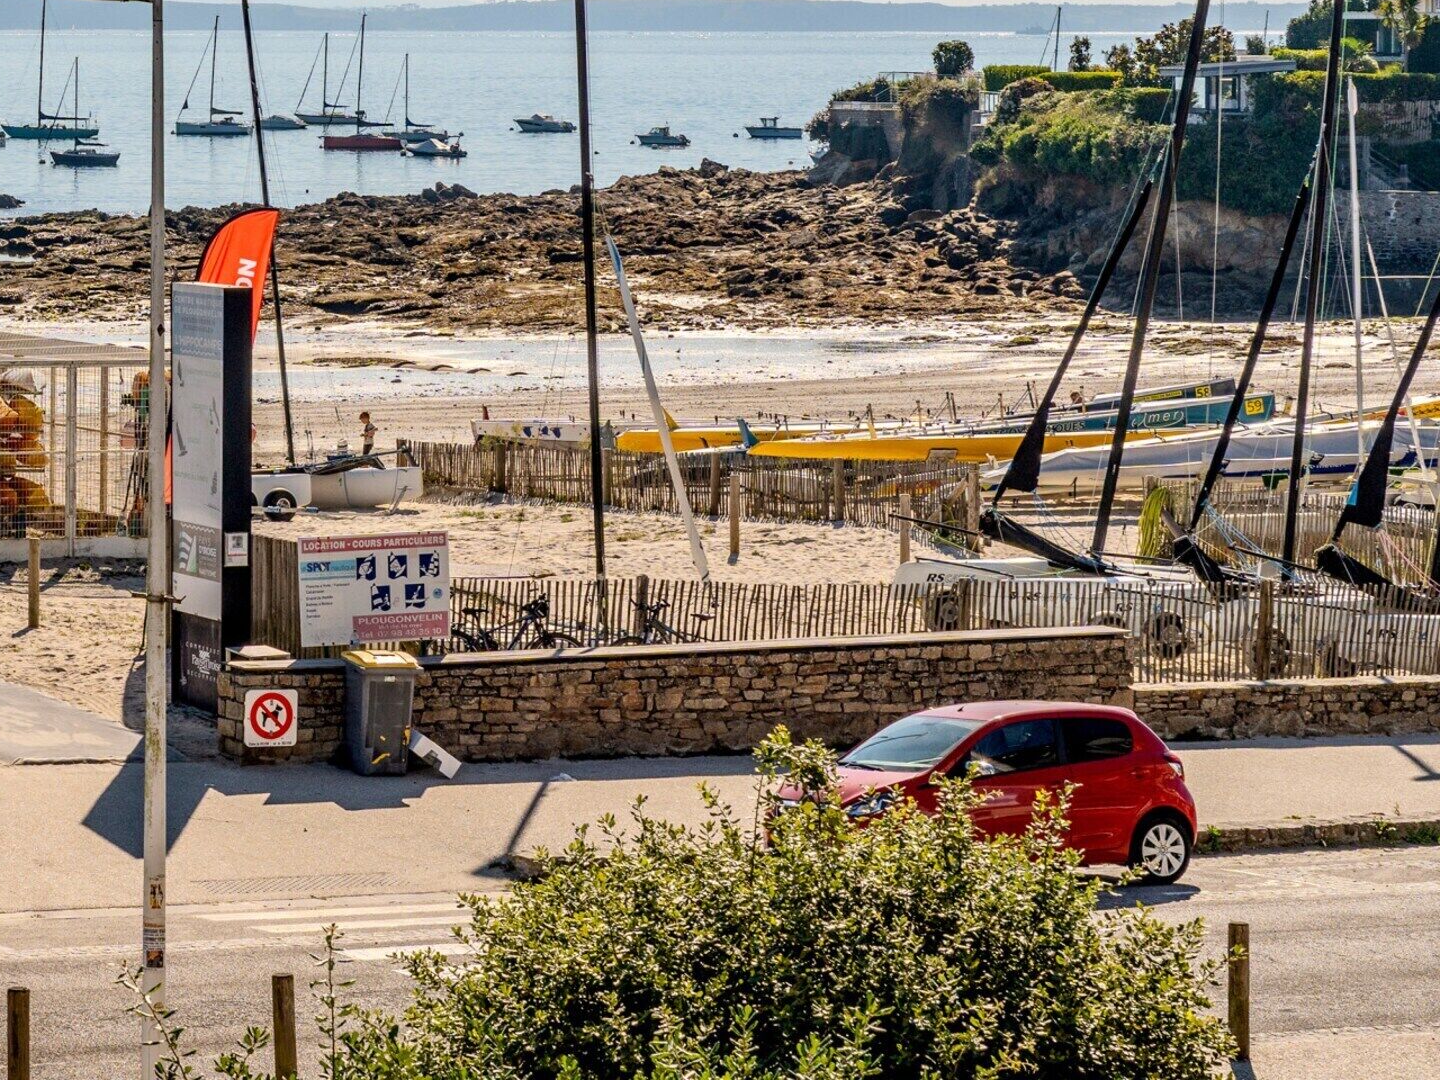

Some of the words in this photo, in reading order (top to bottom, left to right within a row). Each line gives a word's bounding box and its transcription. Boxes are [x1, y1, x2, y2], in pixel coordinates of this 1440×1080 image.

[1196, 386, 1209, 398] 58
[1247, 399, 1262, 413] 59
[303, 541, 345, 551] LOCATION
[352, 539, 382, 549] COURS
[383, 535, 444, 547] PARTICULIERS
[306, 561, 331, 573] SPOT
[358, 613, 443, 625] PLOUGONVELIN
